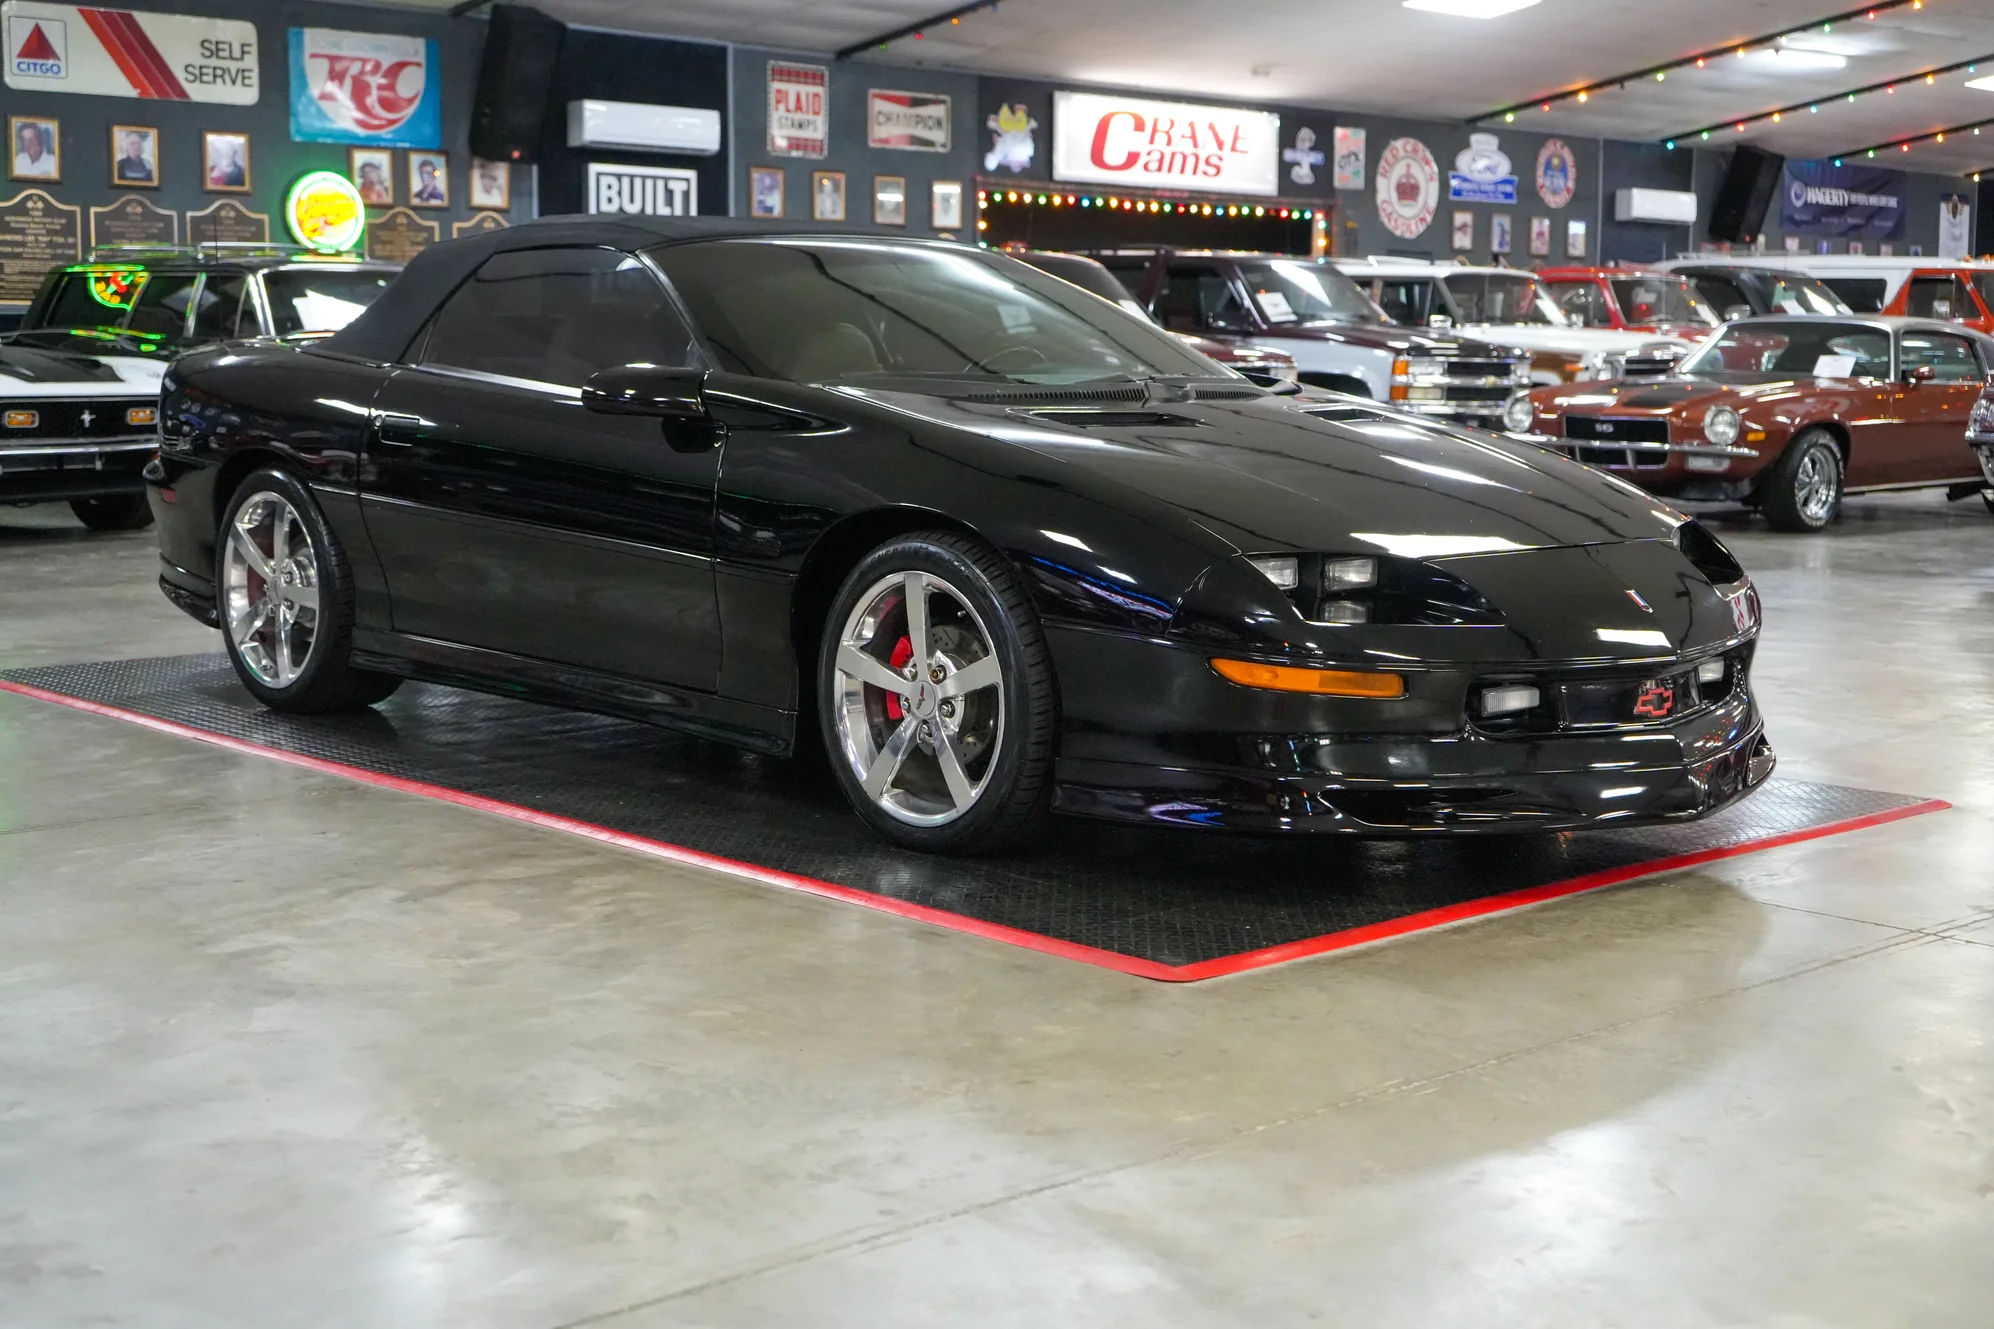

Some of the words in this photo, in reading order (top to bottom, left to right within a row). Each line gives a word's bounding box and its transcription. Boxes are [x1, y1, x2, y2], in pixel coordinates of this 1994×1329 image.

[199, 39, 253, 61] SELF
[16, 60, 62, 76] CITGO
[183, 64, 254, 87] SERVE
[774, 89, 822, 116] PLAID
[777, 116, 818, 133] STAMPS
[598, 174, 689, 217] BUILT
